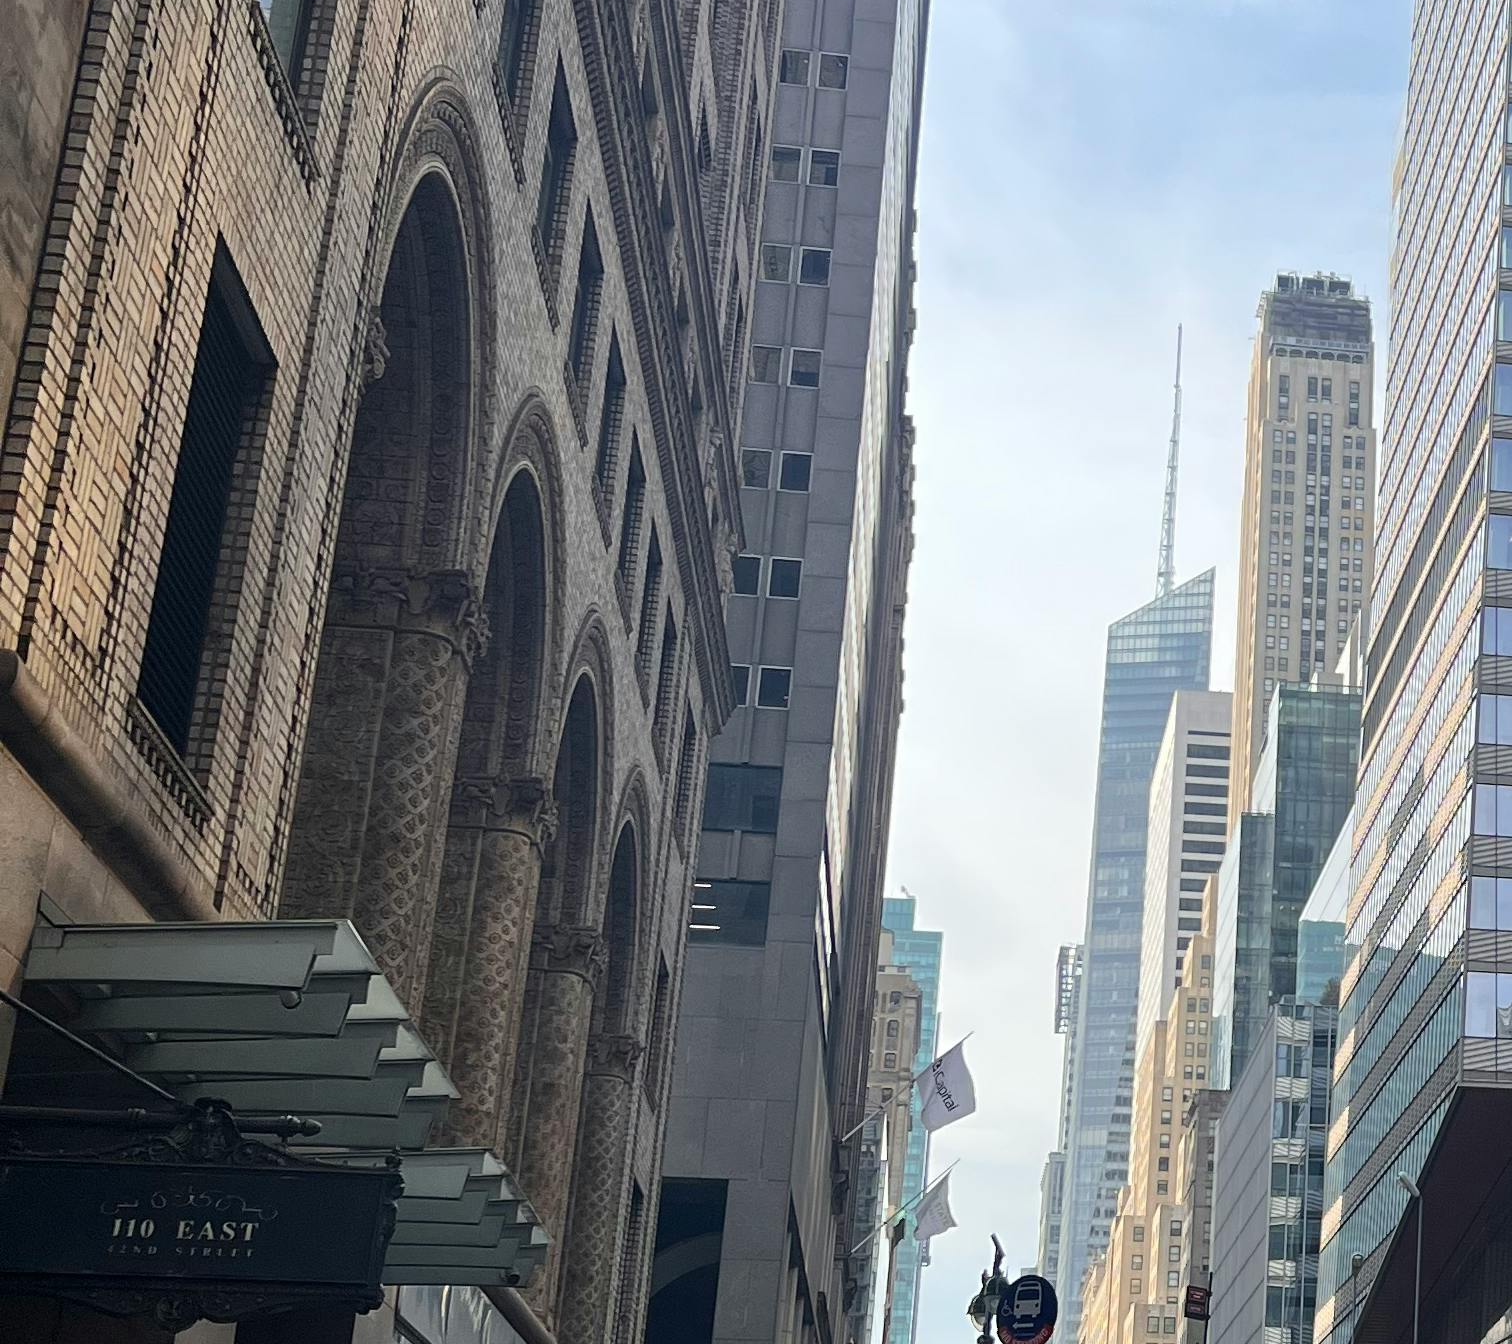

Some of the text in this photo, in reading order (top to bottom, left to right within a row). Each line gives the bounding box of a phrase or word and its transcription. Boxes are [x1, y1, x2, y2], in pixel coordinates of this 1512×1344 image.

[933, 1071, 960, 1112] iCapital
[112, 1218, 259, 1241] 110 EAST
